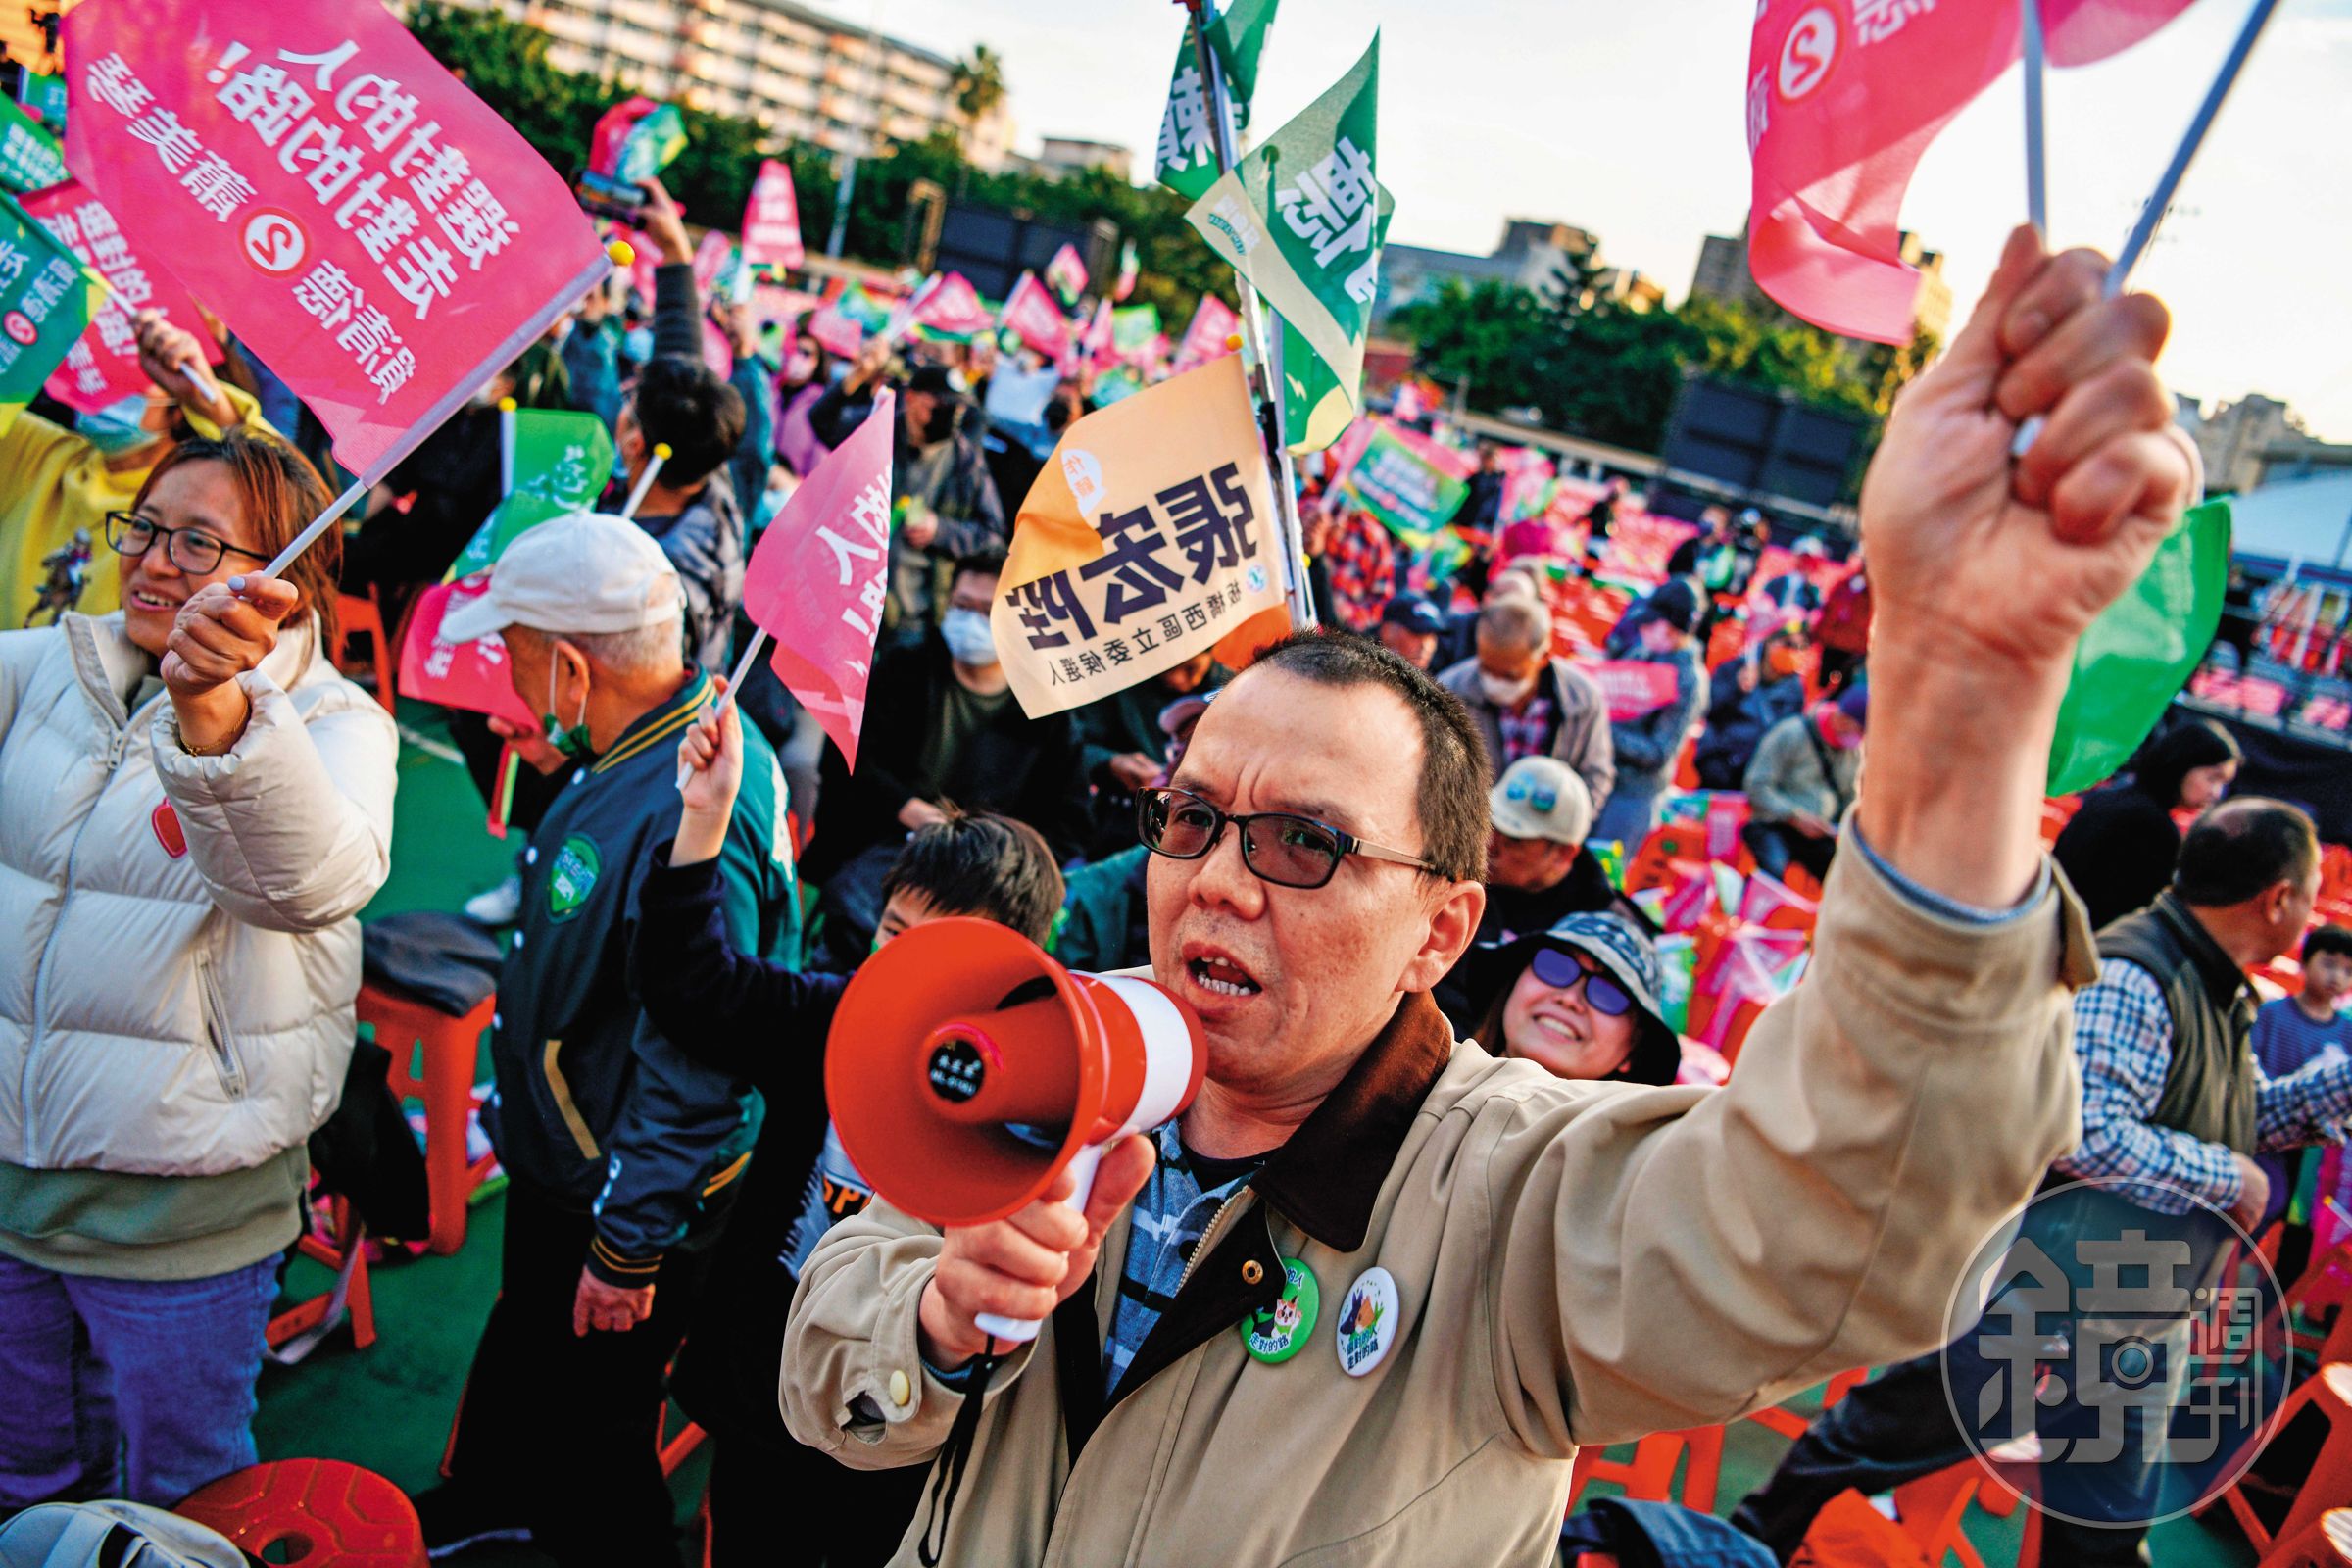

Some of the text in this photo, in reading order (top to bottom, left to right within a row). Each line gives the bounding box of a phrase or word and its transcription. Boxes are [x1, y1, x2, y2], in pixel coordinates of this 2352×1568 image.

[75, 201, 168, 318] 選對的
[1249, 1333, 1290, 1353] 走對的路
